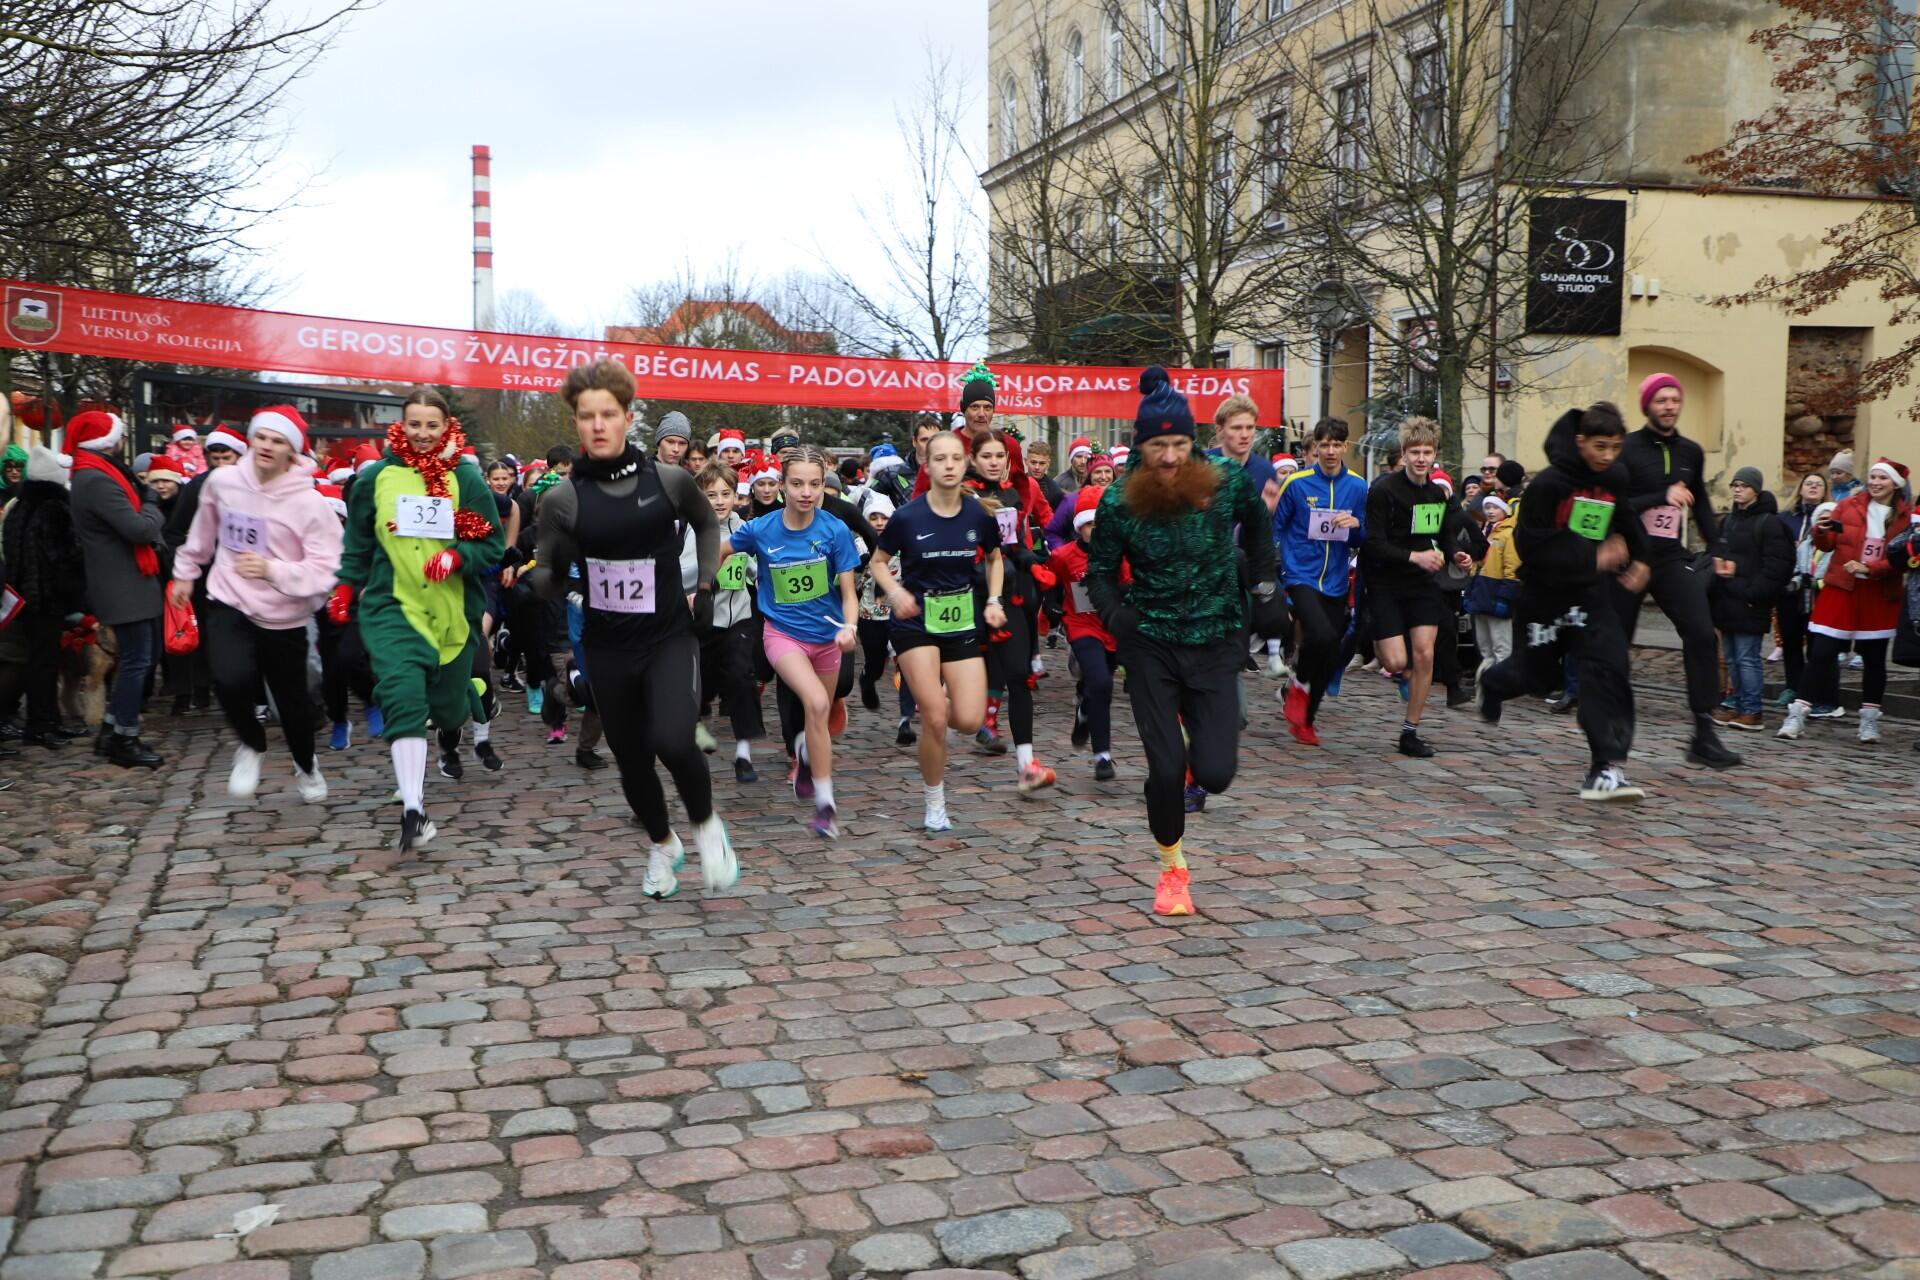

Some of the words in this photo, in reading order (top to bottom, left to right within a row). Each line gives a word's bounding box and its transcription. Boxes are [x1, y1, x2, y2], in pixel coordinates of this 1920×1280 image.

[1540, 272, 1583, 283] SANDRA
[1556, 284, 1596, 293] STUDIO
[81, 305, 171, 326] LIETUVOS
[80, 323, 150, 342] VERSLO
[156, 332, 243, 353] KOLEGIJA
[296, 325, 457, 361] GEROSIOS
[633, 350, 761, 383] BĖGIMAS
[789, 363, 964, 390] PADOVANOK
[1173, 373, 1251, 397] LĖDAS
[502, 373, 563, 388] STARTA
[997, 392, 1043, 408] NIŠAS
[412, 504, 438, 525] 32
[1424, 513, 1440, 526] 11
[1654, 514, 1674, 530] 52
[225, 523, 259, 545] 118
[999, 521, 1012, 537] 21
[1864, 544, 1881, 557] 51
[726, 565, 743, 581] 16
[599, 578, 644, 601] 112
[788, 575, 814, 594] 39
[939, 606, 961, 623] 40
